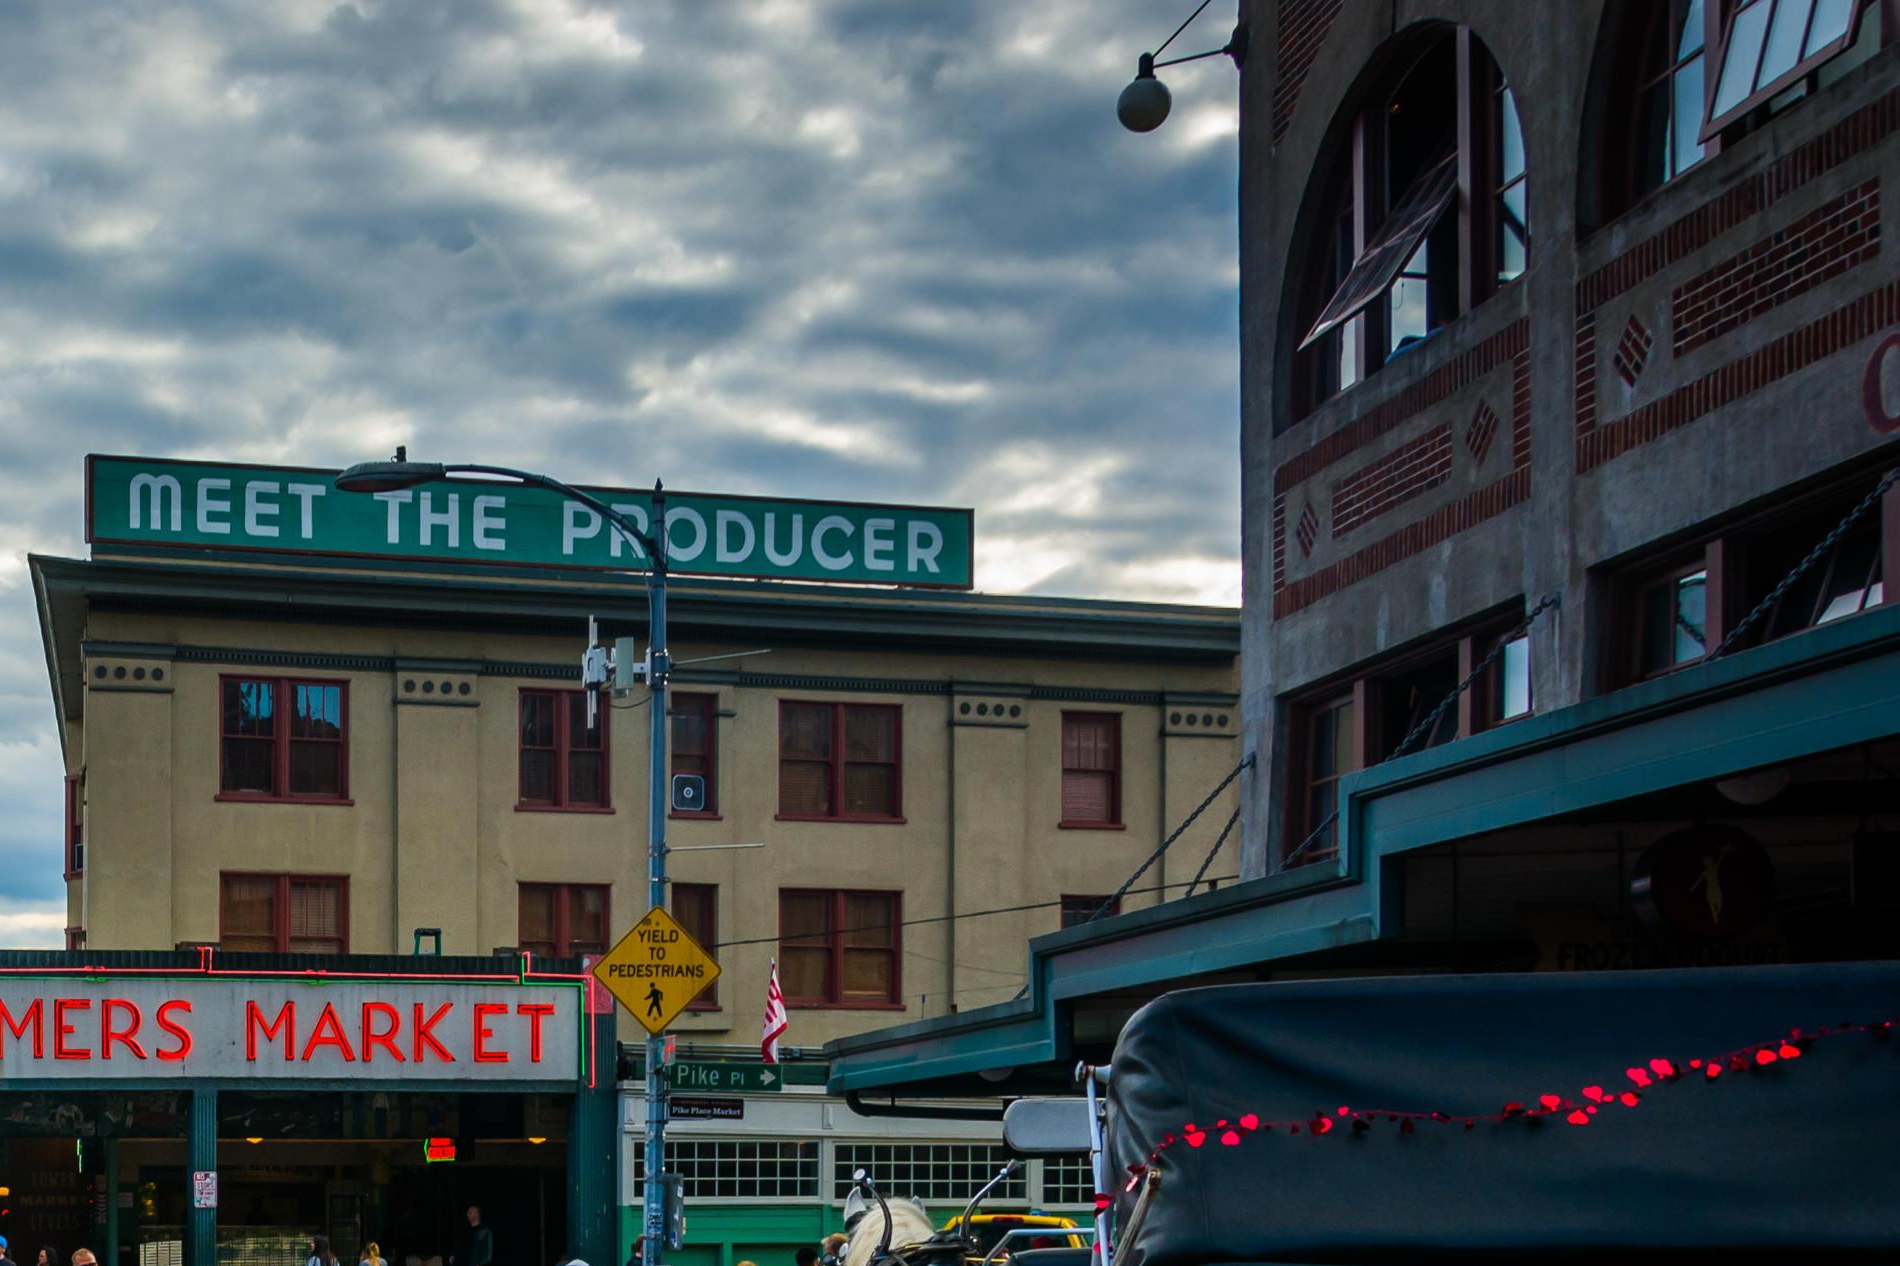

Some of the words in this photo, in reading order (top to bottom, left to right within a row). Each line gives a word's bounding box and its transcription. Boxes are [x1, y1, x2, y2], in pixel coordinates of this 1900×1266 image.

[129, 473, 326, 539] MEET
[373, 490, 506, 551] THE
[562, 500, 944, 573] PRODUCER
[637, 930, 679, 943] YIELD
[649, 947, 666, 960] TO
[609, 964, 704, 978] PEDESTRIANS
[246, 1001, 556, 1063] MARKET
[677, 1065, 719, 1085] Pike
[731, 1072, 745, 1085] Pl
[672, 1106, 690, 1114] Pike
[691, 1107, 711, 1115] Place
[713, 1108, 741, 1116] Market
